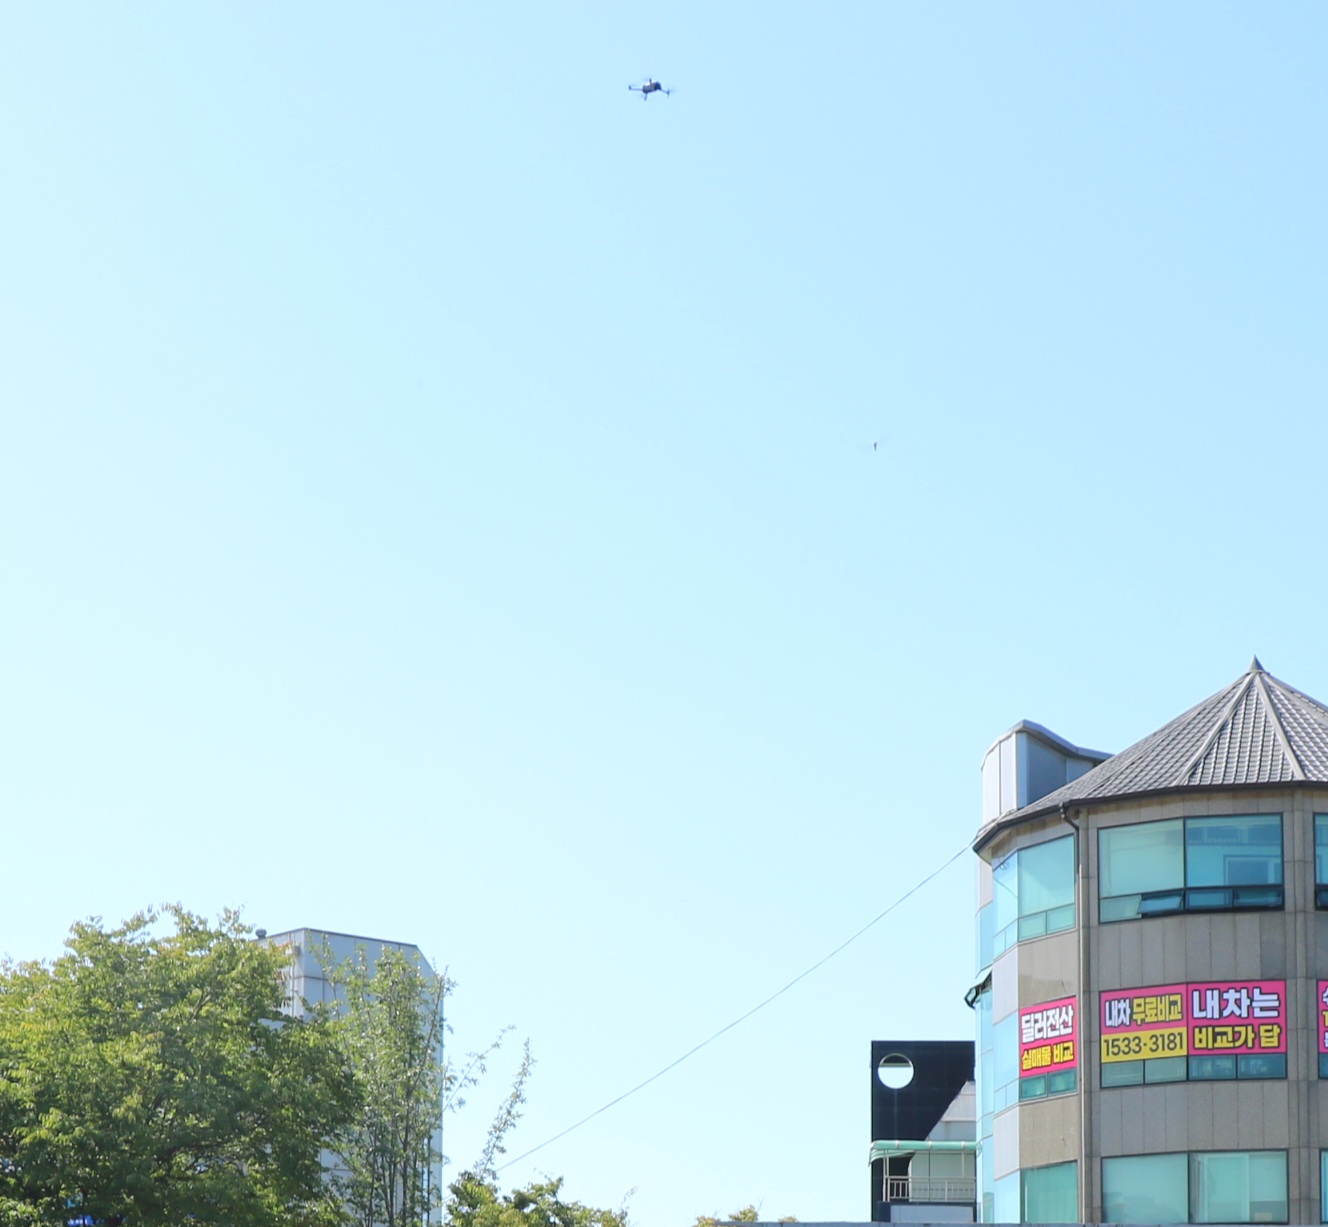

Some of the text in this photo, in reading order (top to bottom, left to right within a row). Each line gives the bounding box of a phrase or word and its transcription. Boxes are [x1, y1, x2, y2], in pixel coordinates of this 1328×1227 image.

[1105, 993, 1183, 1027] 내차 무료비교
[1192, 987, 1280, 1020] 내차는
[1020, 1004, 1074, 1043] 딜러전산
[1194, 1024, 1280, 1050] 비교가 답
[1052, 1041, 1075, 1064] 비교
[1103, 1032, 1184, 1057] 1533-3181
